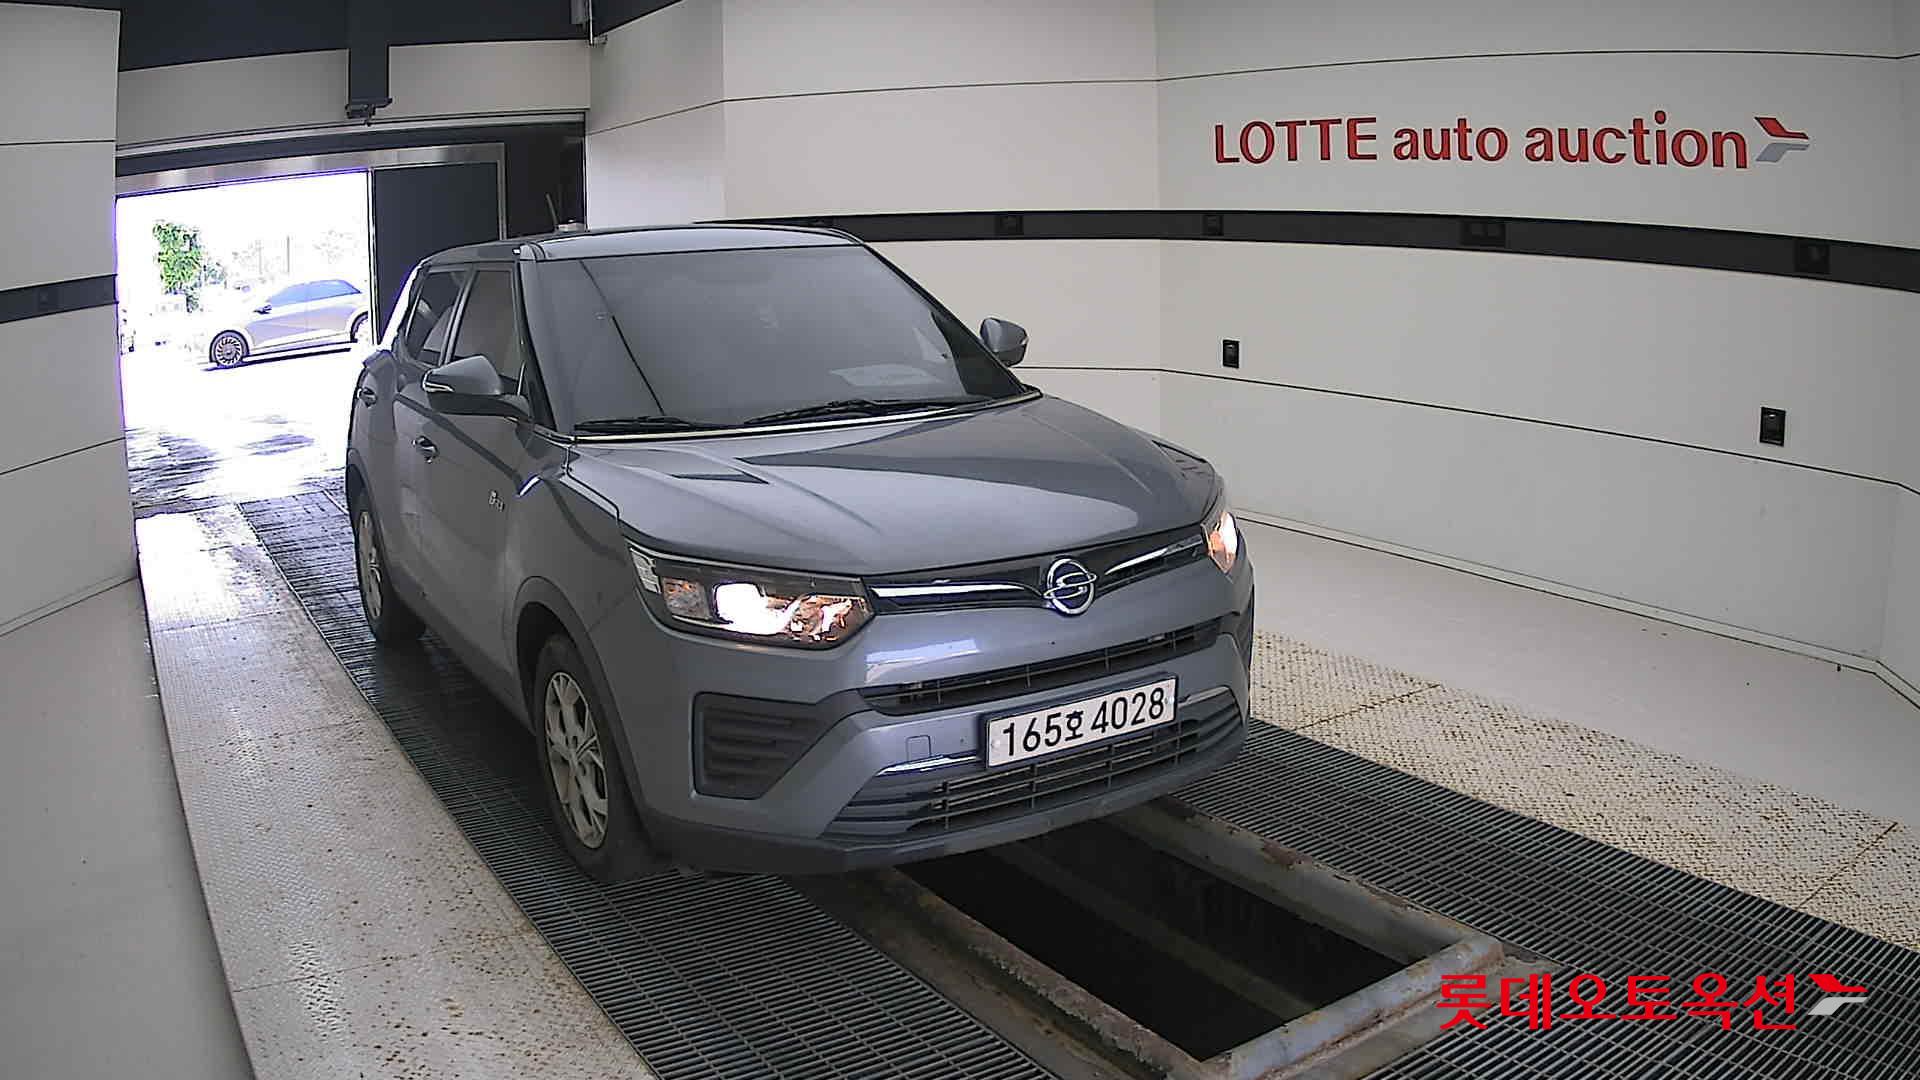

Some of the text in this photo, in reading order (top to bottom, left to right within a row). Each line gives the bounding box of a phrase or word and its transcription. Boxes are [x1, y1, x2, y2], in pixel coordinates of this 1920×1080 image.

[1215, 111, 1748, 169] LOTTE auto auction
[1002, 687, 1165, 757] 165호 4028
